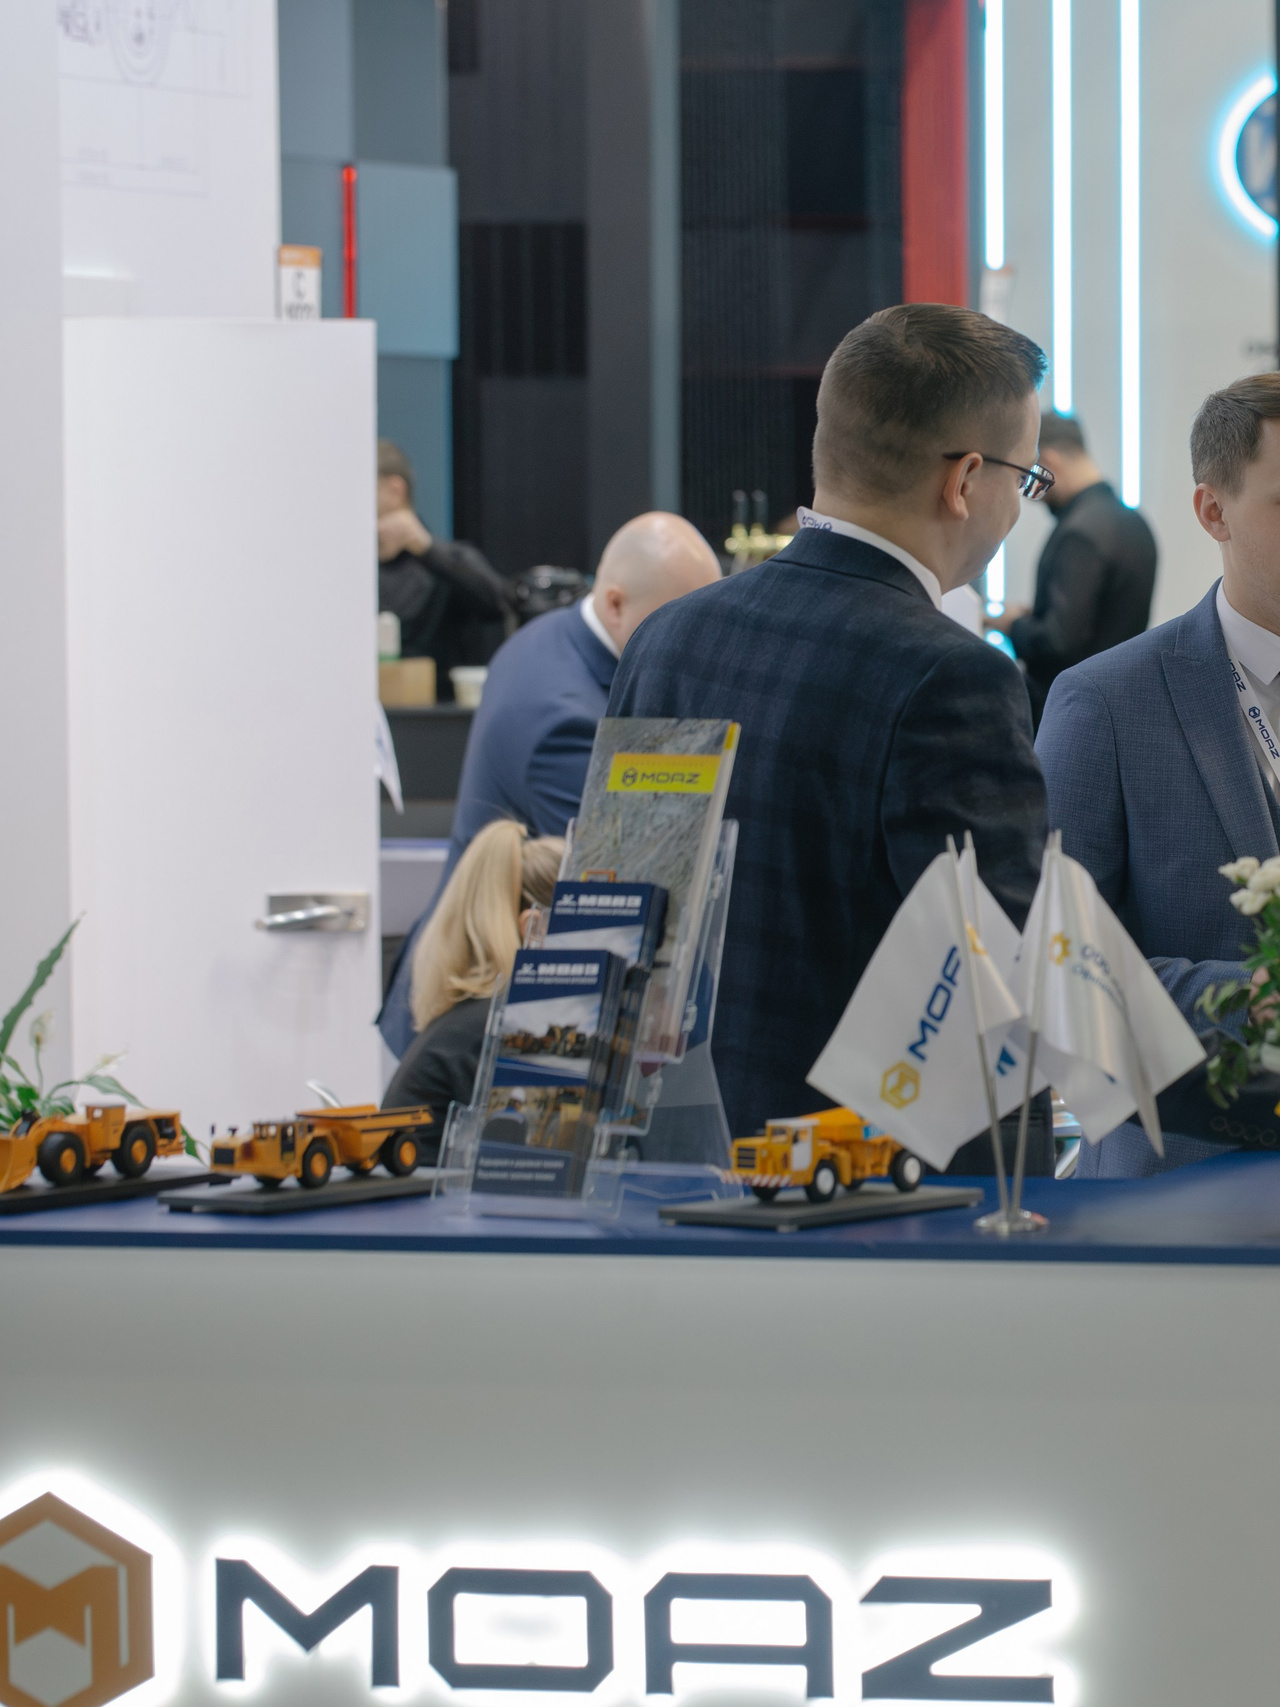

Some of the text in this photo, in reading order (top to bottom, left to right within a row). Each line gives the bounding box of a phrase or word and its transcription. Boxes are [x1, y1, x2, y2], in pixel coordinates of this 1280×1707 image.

[1255, 718, 1280, 759] MOAZ
[640, 772, 701, 784] MOAZ
[214, 1557, 1055, 1704] MOAZ
